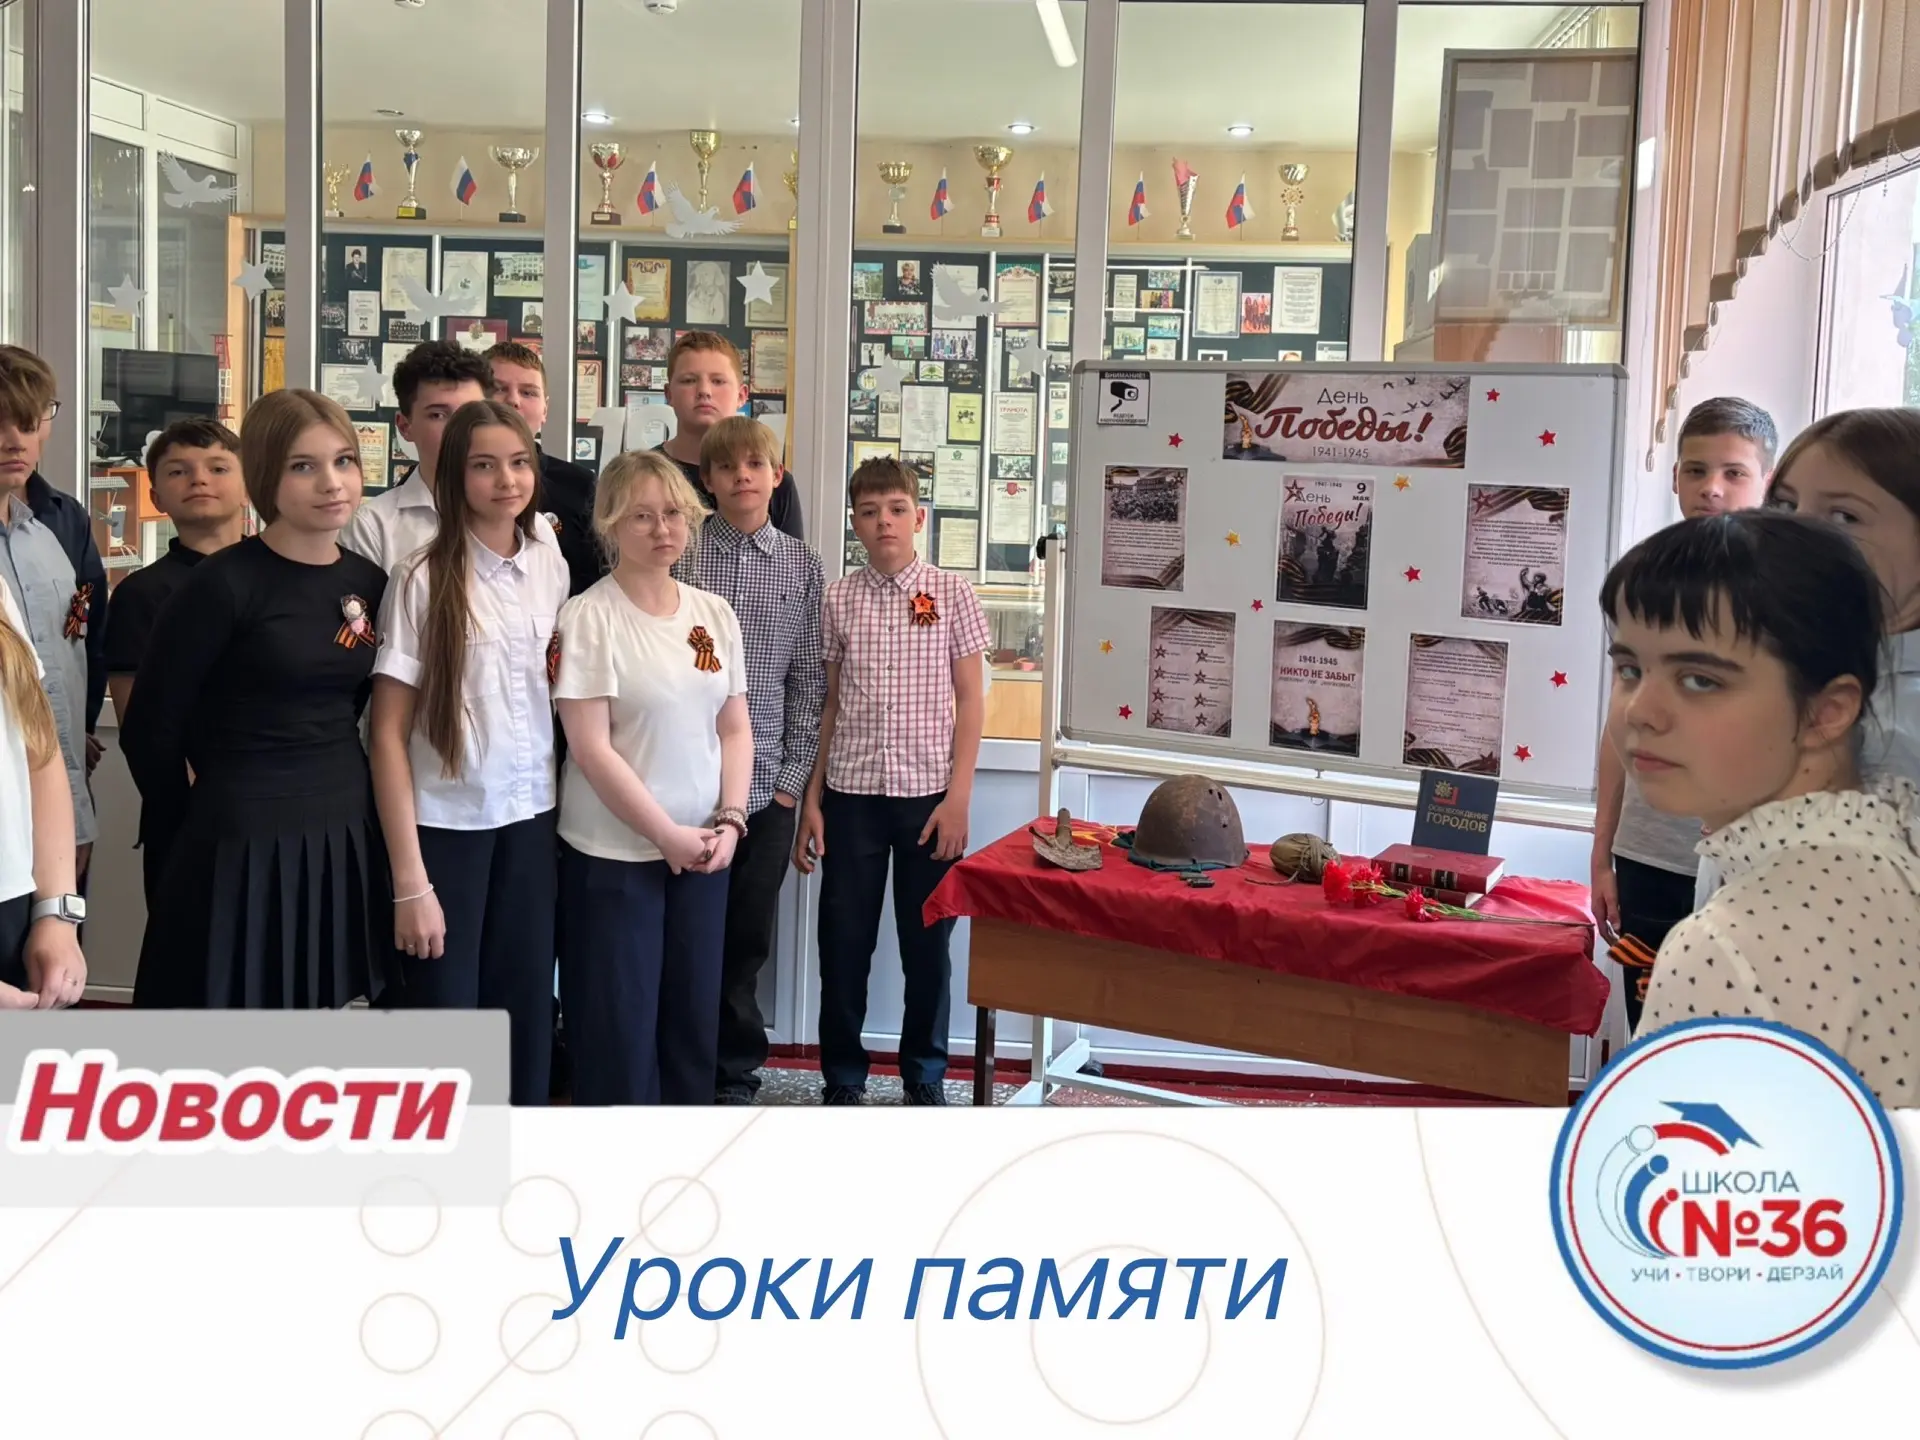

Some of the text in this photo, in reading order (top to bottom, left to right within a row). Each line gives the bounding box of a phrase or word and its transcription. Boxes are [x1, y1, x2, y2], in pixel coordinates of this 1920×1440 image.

[1317, 388, 1369, 405] День
[1254, 406, 1434, 443] Победы!
[1312, 446, 1369, 459] 1941-1945
[1356, 482, 1367, 494] 9
[1295, 490, 1332, 504] День
[1294, 502, 1364, 531] Победы!
[1298, 655, 1339, 666] 1941-1945
[1280, 665, 1310, 678] НИКТО
[1311, 669, 1324, 679] НЕ
[1324, 671, 1357, 682] ЗАБЫТ
[1426, 811, 1488, 833] ГОРОДОВ
